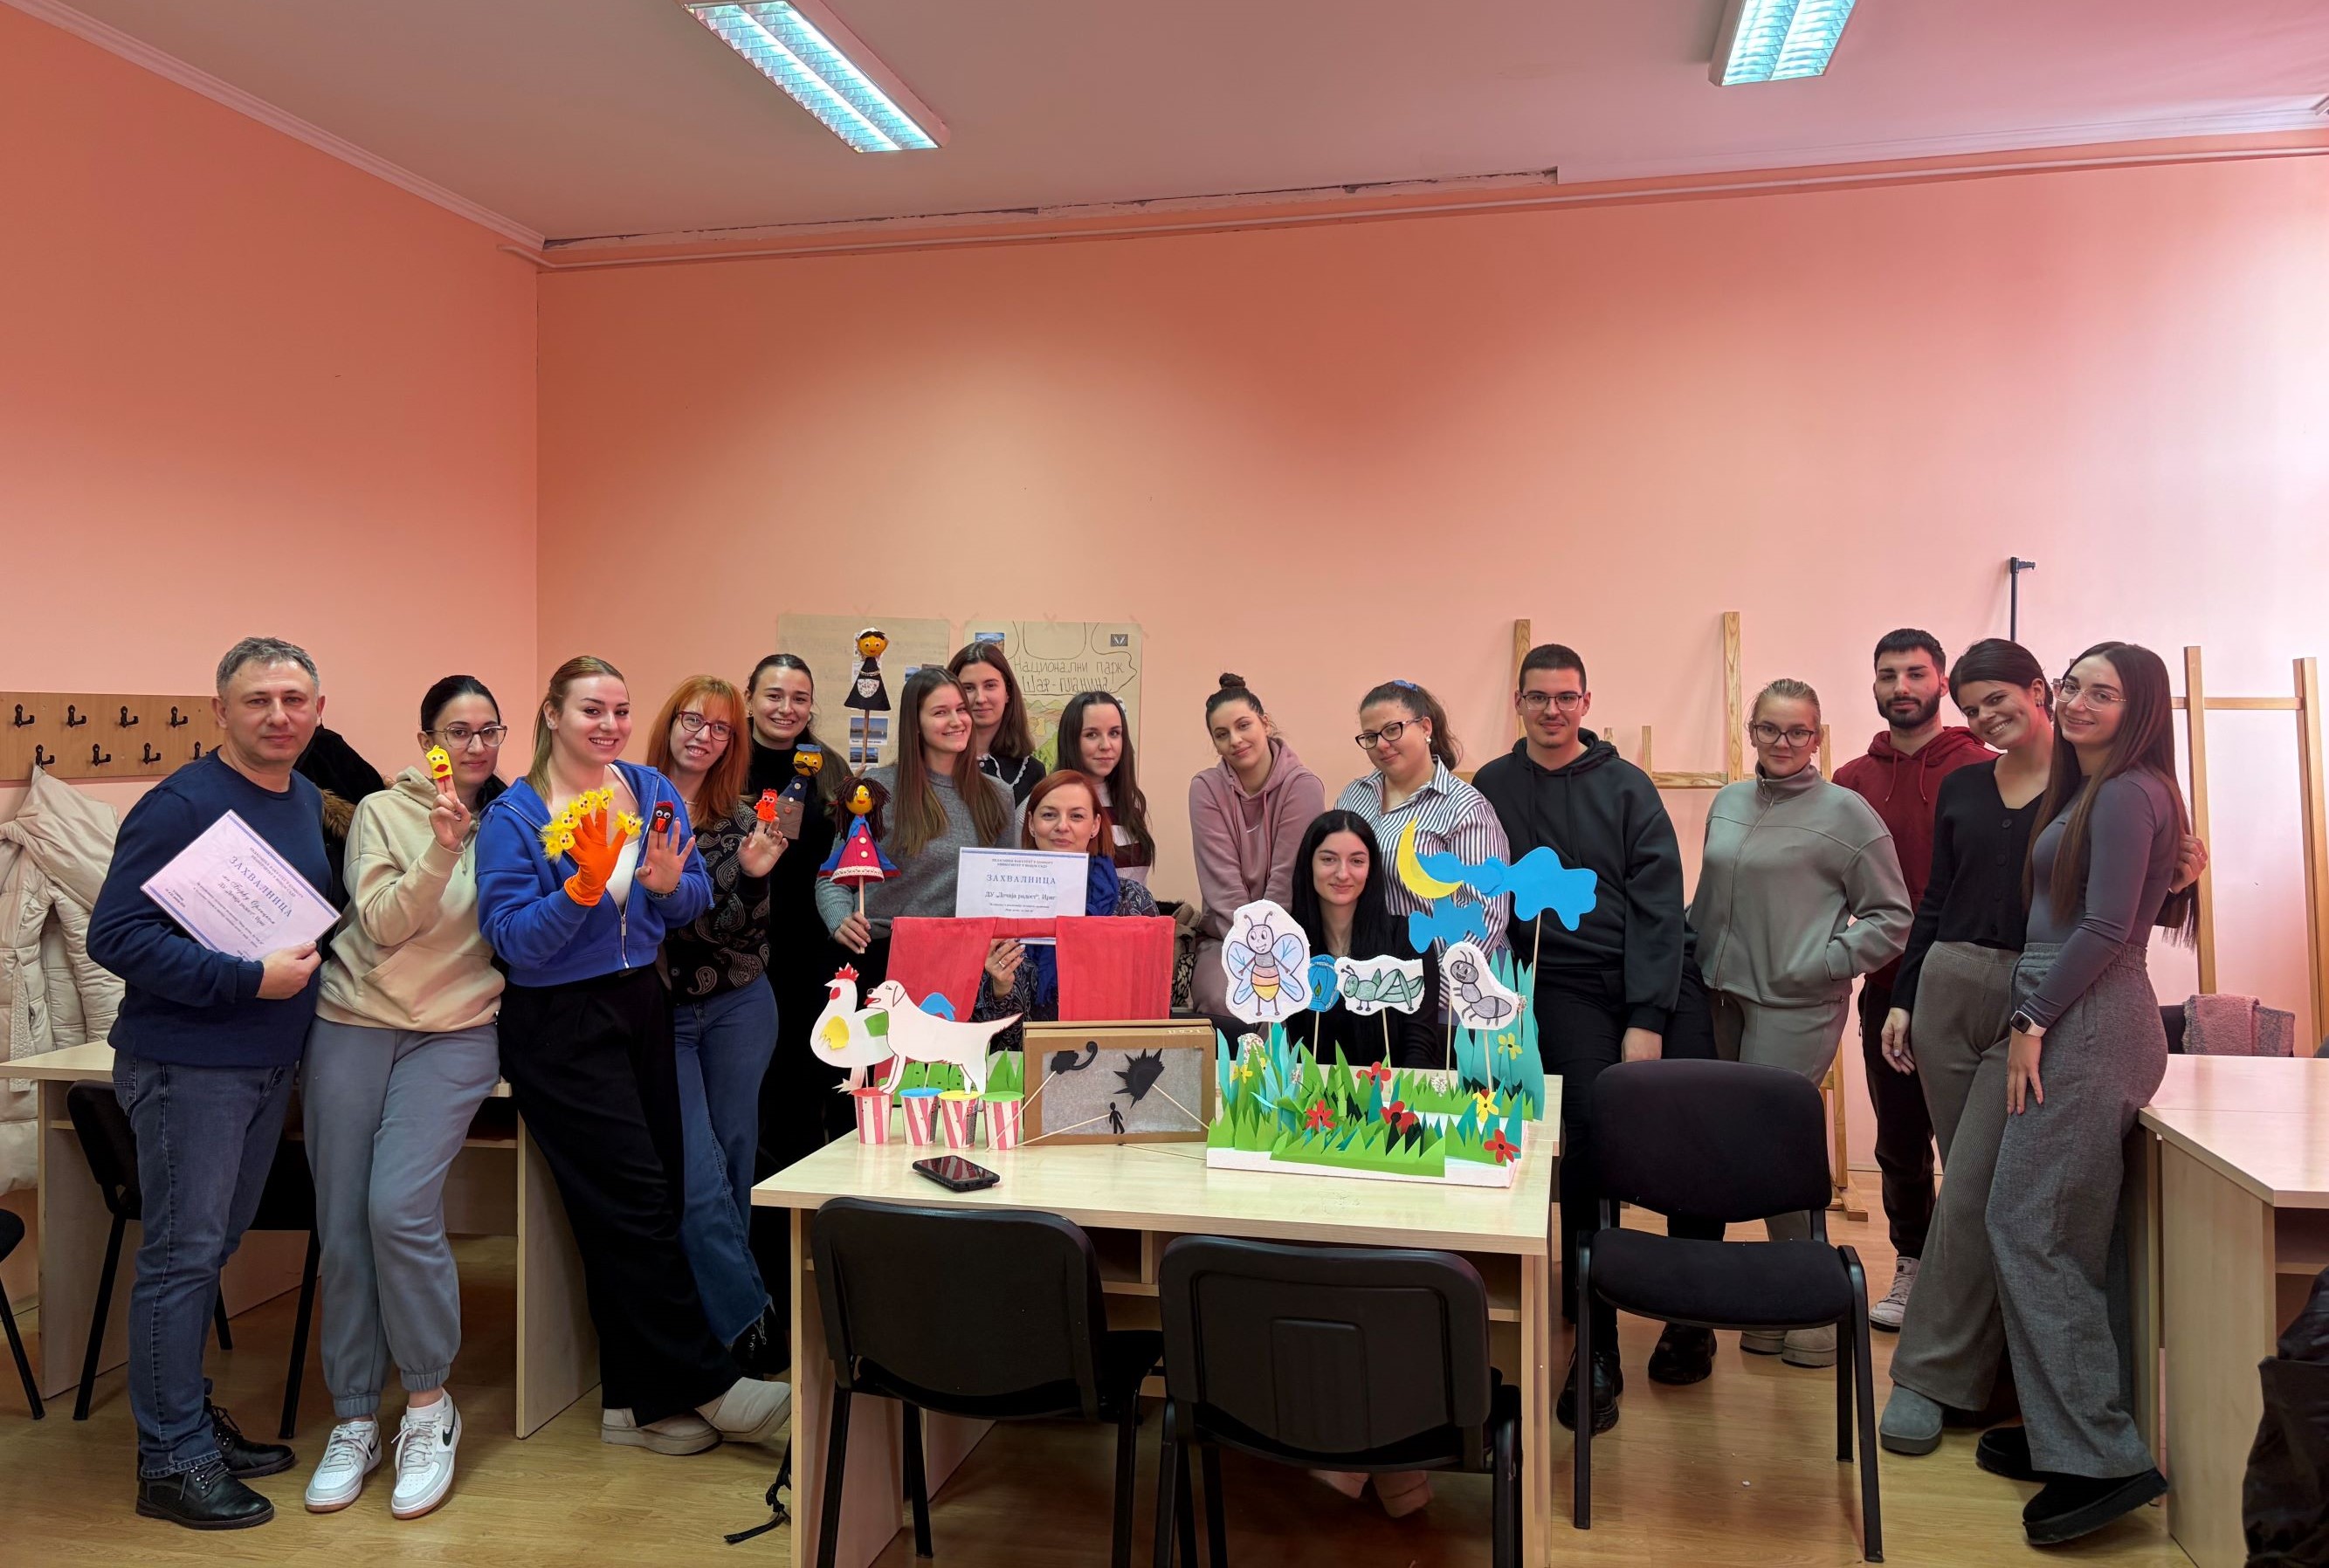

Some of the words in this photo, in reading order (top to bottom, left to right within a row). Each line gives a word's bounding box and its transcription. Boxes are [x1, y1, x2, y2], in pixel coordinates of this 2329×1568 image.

[1013, 656, 1088, 675] Национални
[1096, 661, 1125, 684] парк
[230, 856, 293, 918] ЗАХВАЛНИЦА
[986, 874, 1056, 884] ЗАХВАЛНИЦА
